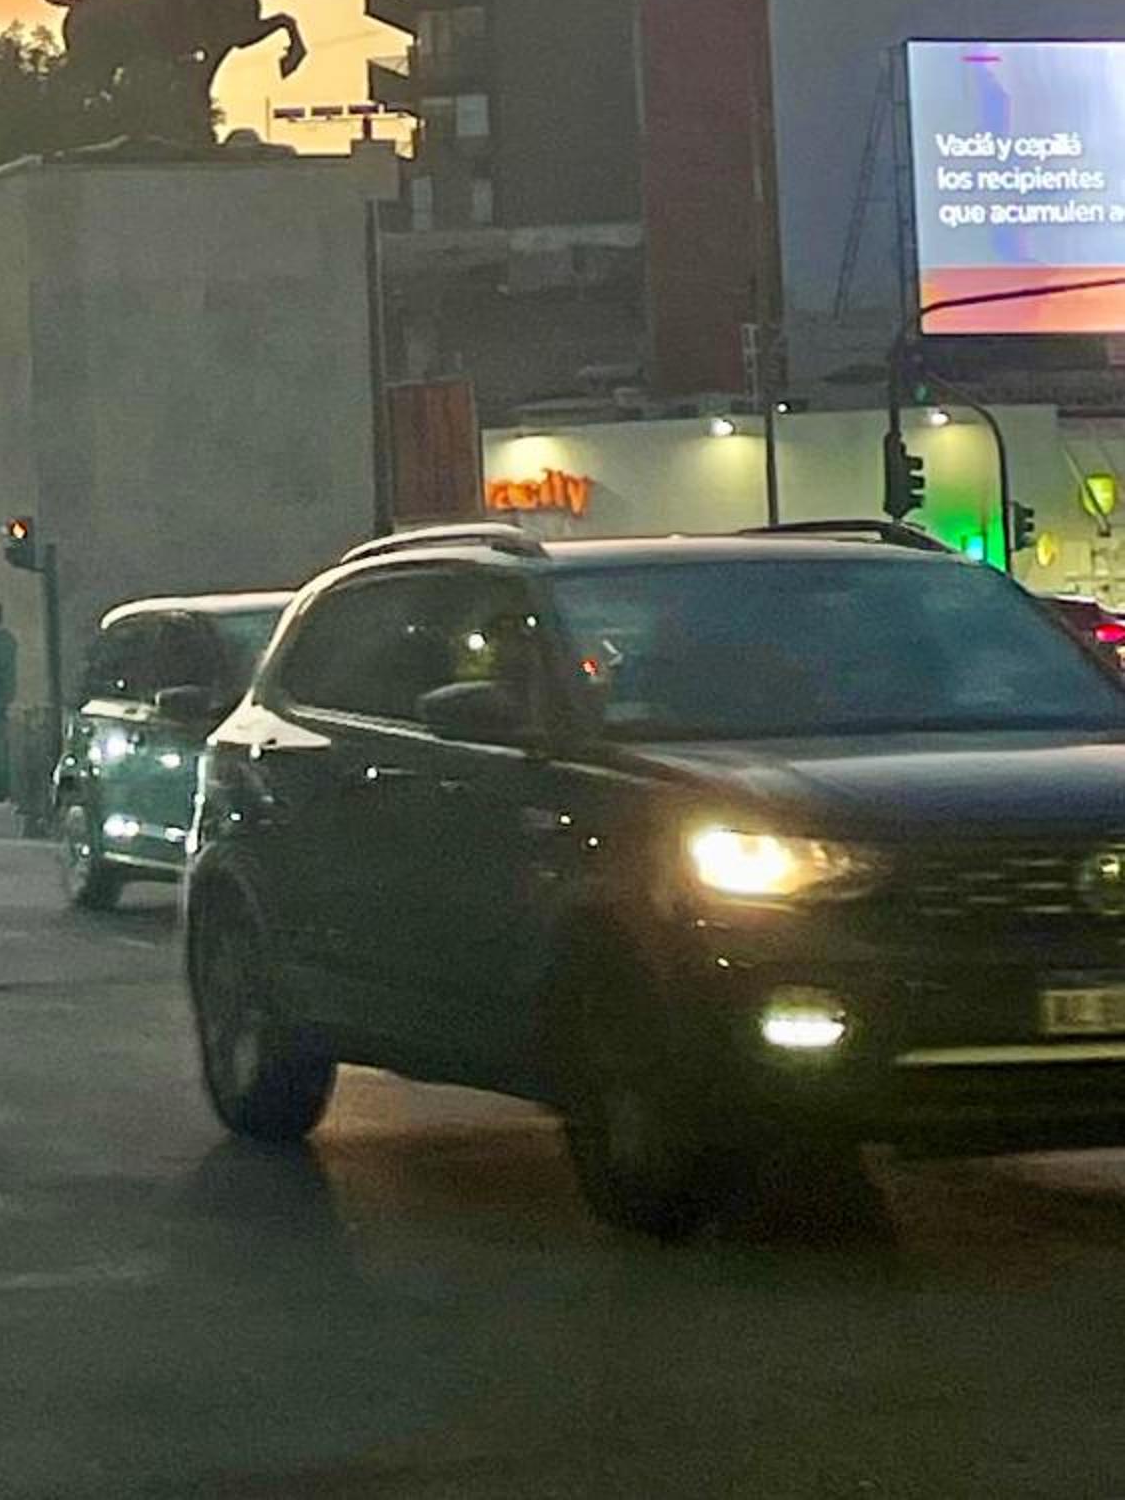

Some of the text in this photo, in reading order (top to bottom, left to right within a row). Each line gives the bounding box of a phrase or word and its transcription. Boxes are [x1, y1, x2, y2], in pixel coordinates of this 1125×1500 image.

[935, 132, 996, 157] Vaciá
[995, 137, 1012, 161] y
[937, 166, 1105, 194] los recipientes
[939, 204, 986, 228] que
[989, 200, 1105, 224] acumulen
